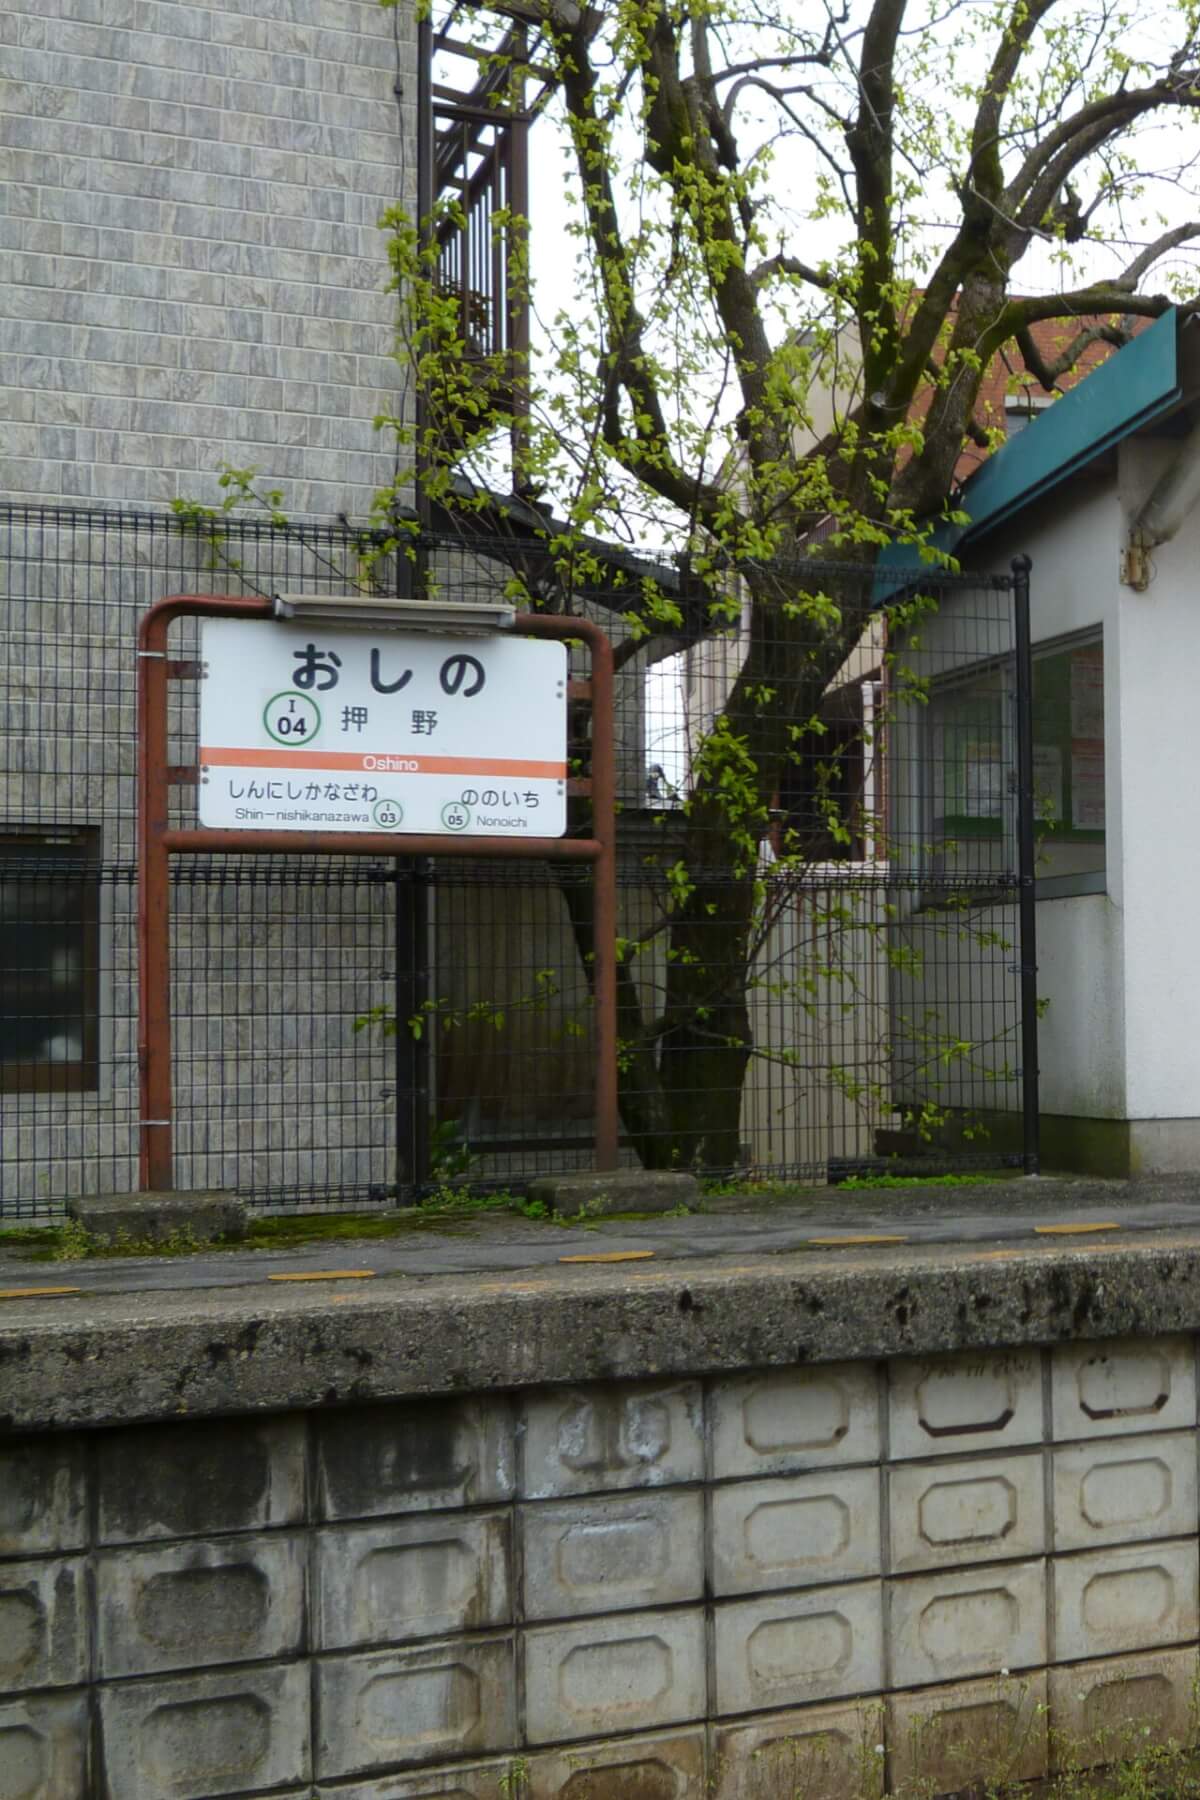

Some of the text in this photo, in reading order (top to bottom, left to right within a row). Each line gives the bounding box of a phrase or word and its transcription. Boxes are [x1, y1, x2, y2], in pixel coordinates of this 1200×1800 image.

[292, 643, 486, 697] おしの
[277, 716, 307, 736] 04
[341, 705, 438, 736] 押野
[362, 755, 419, 772] Oshino
[228, 779, 379, 803] しんにしかなざわ
[460, 788, 540, 808] ののいち
[379, 812, 397, 824] 03
[447, 814, 464, 826] 05
[475, 815, 528, 828] Nonoichi
